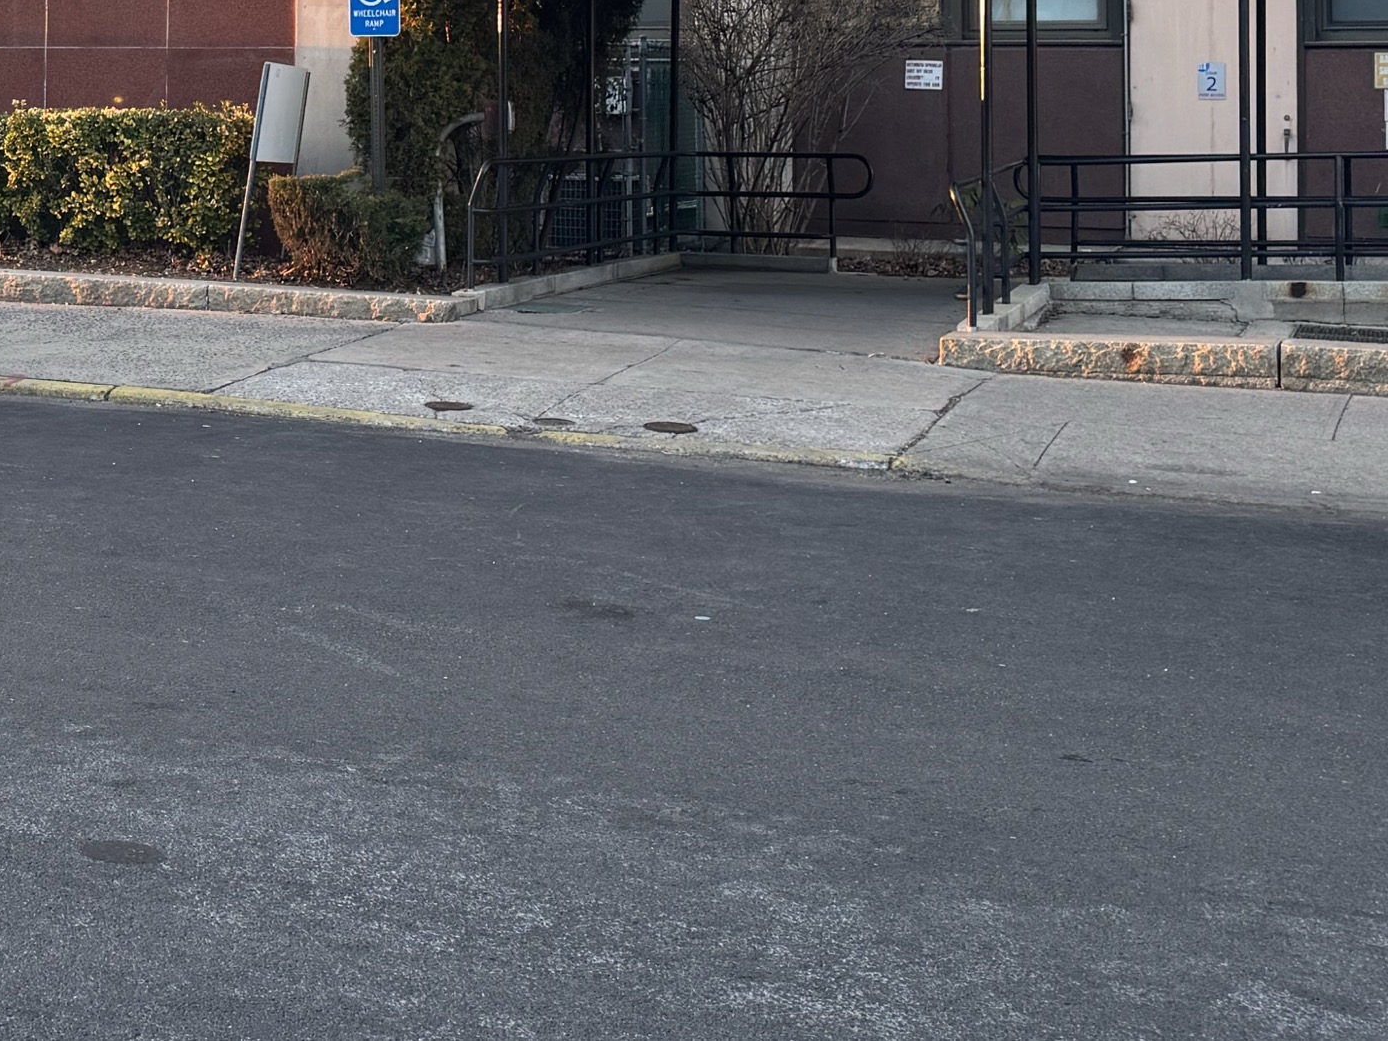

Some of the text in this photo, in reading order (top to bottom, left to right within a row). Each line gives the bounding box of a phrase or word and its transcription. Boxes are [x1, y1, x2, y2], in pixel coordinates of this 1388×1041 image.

[353, 9, 396, 18] WHEELCHAIR
[364, 19, 384, 28] RAMP
[1206, 76, 1218, 92] 2
